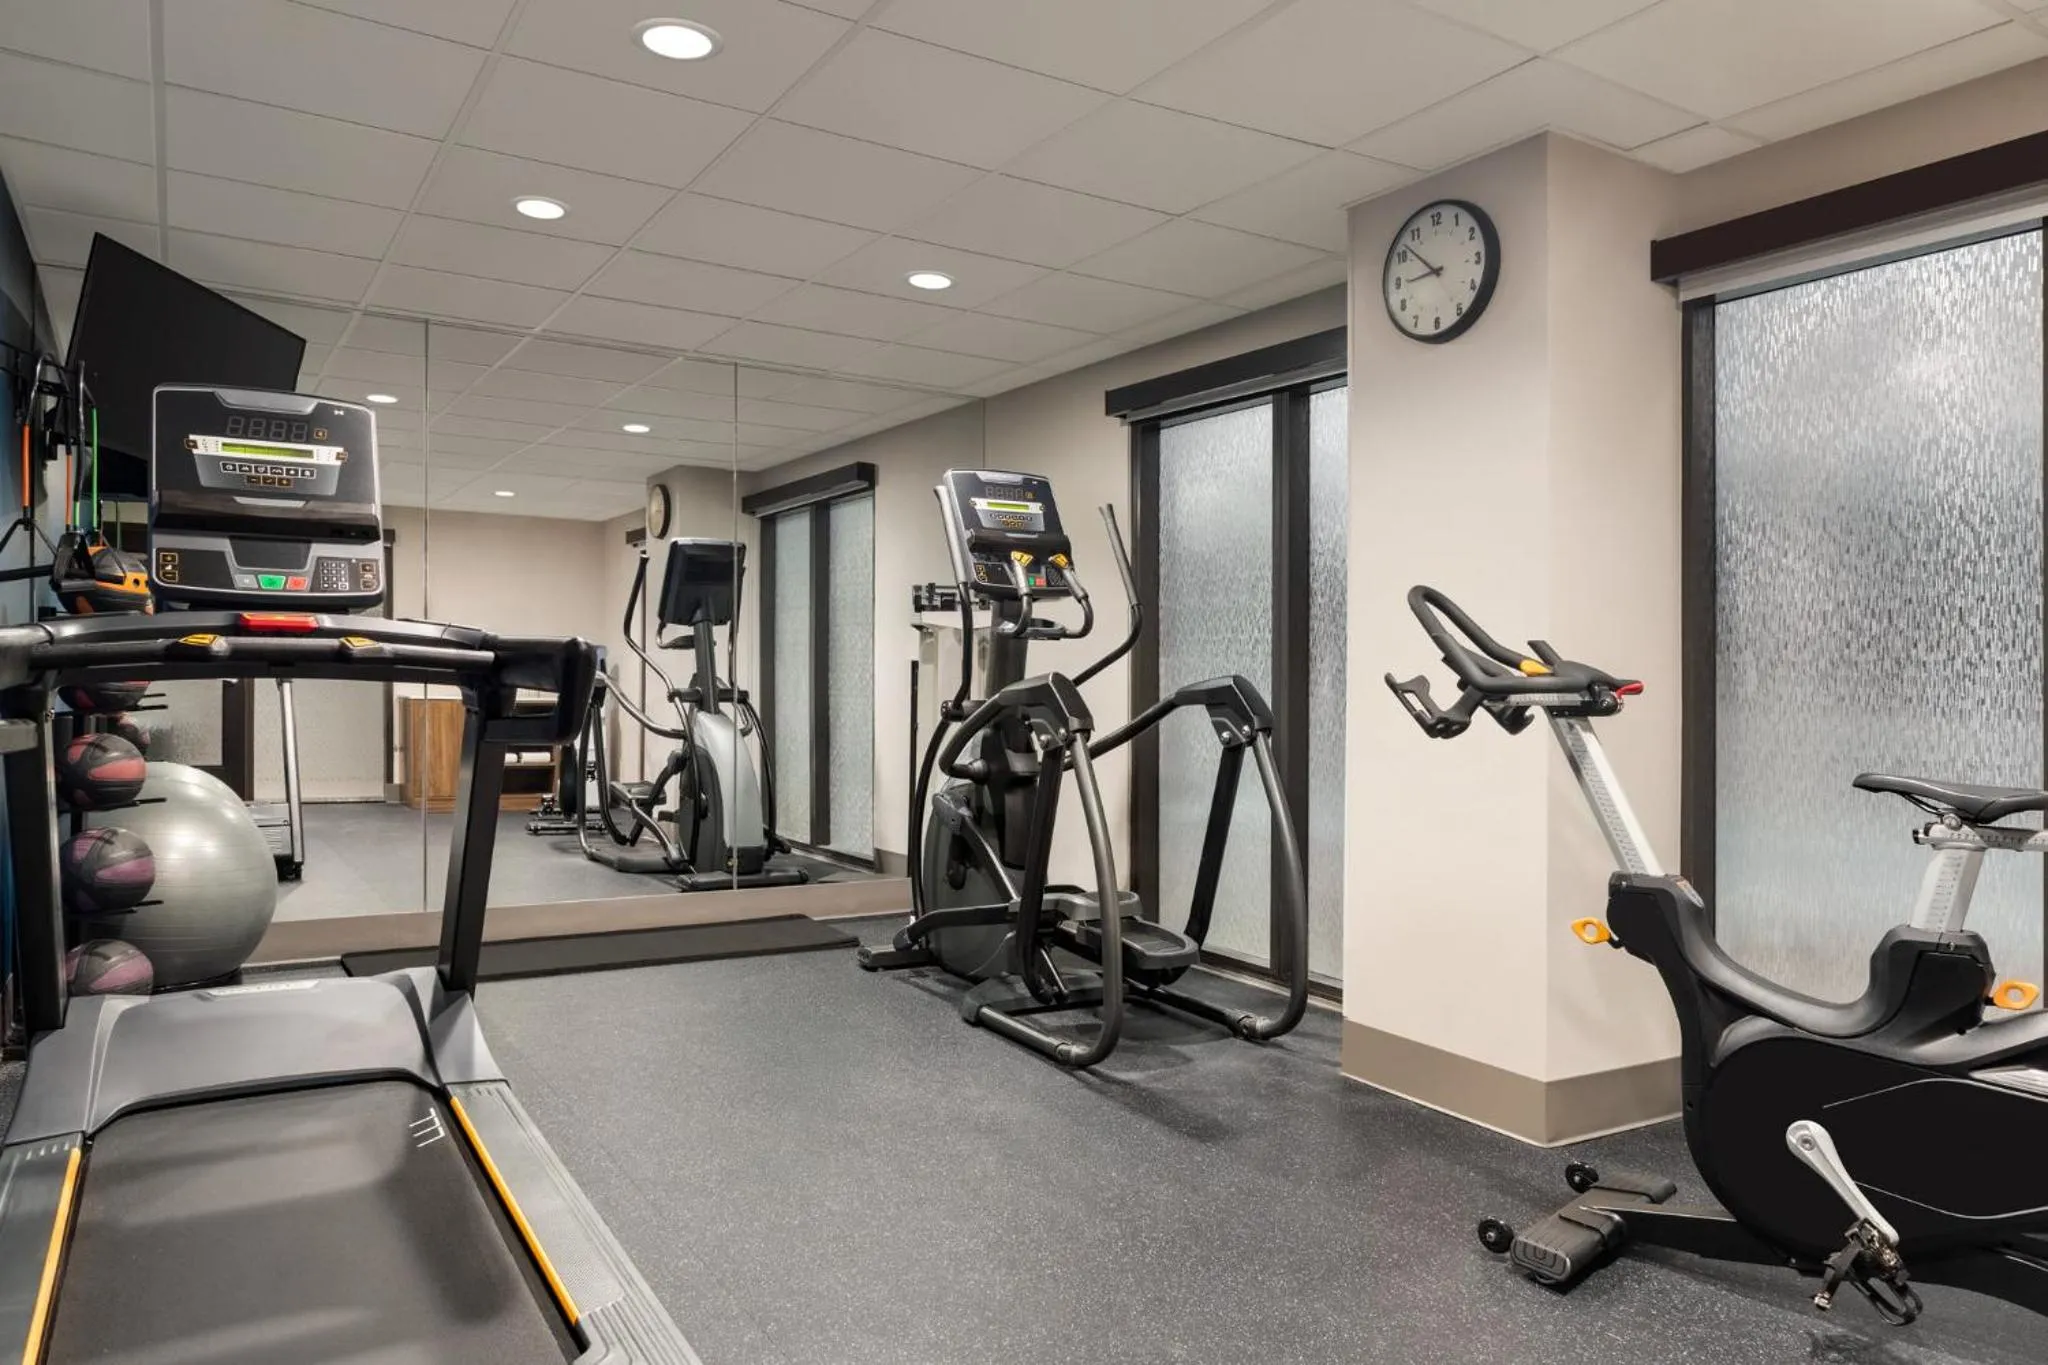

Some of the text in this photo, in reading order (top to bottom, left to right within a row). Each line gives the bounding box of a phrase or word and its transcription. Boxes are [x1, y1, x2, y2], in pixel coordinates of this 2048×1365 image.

[1430, 212, 1442, 227] 12
[1454, 212, 1460, 227] 1
[1411, 226, 1421, 241] 11
[1468, 226, 1475, 240] 2
[1397, 250, 1408, 265] 10
[1474, 251, 1481, 265] 3
[1395, 276, 1401, 290] 9
[1470, 278, 1477, 291] 4
[1400, 298, 1407, 312] 8
[1456, 302, 1463, 316] 5
[1413, 315, 1419, 329] 7
[1434, 316, 1441, 330] 6
